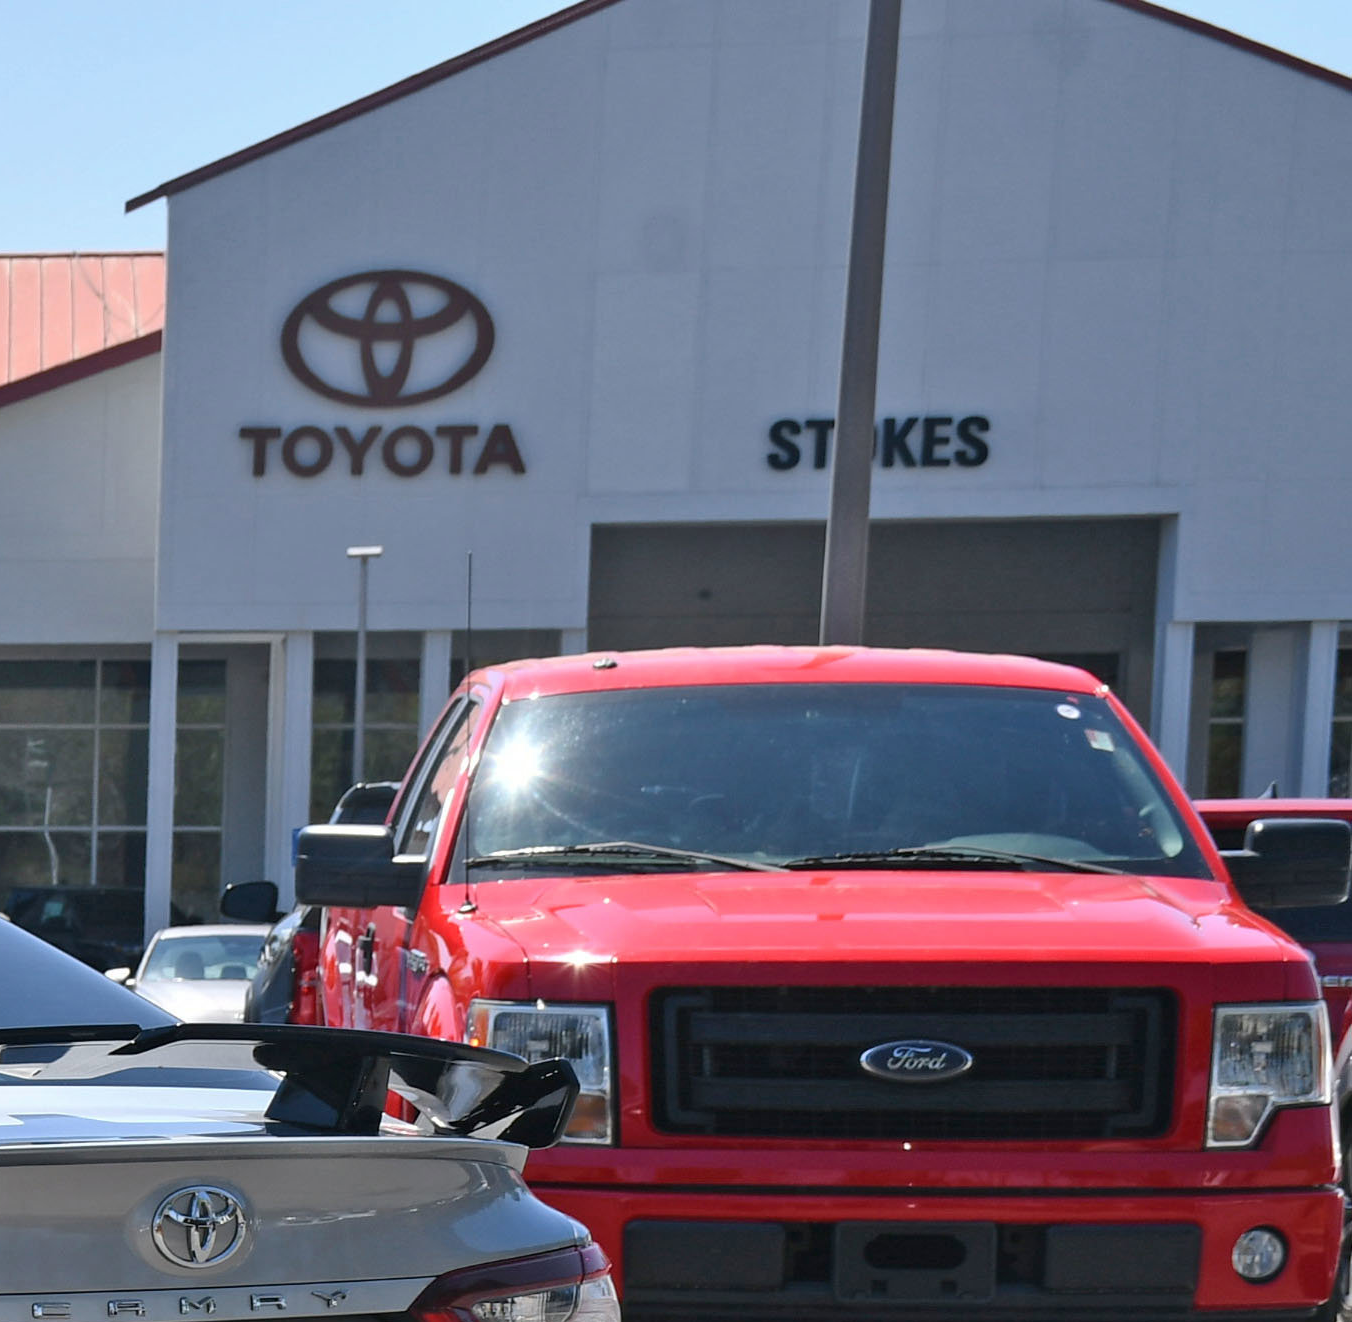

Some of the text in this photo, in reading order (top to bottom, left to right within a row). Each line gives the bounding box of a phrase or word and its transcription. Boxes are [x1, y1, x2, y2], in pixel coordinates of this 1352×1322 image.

[238, 424, 527, 478] TOYOTA
[766, 415, 991, 471] STKES
[886, 1046, 948, 1071] Ford
[31, 1287, 349, 1320] CAMRY
